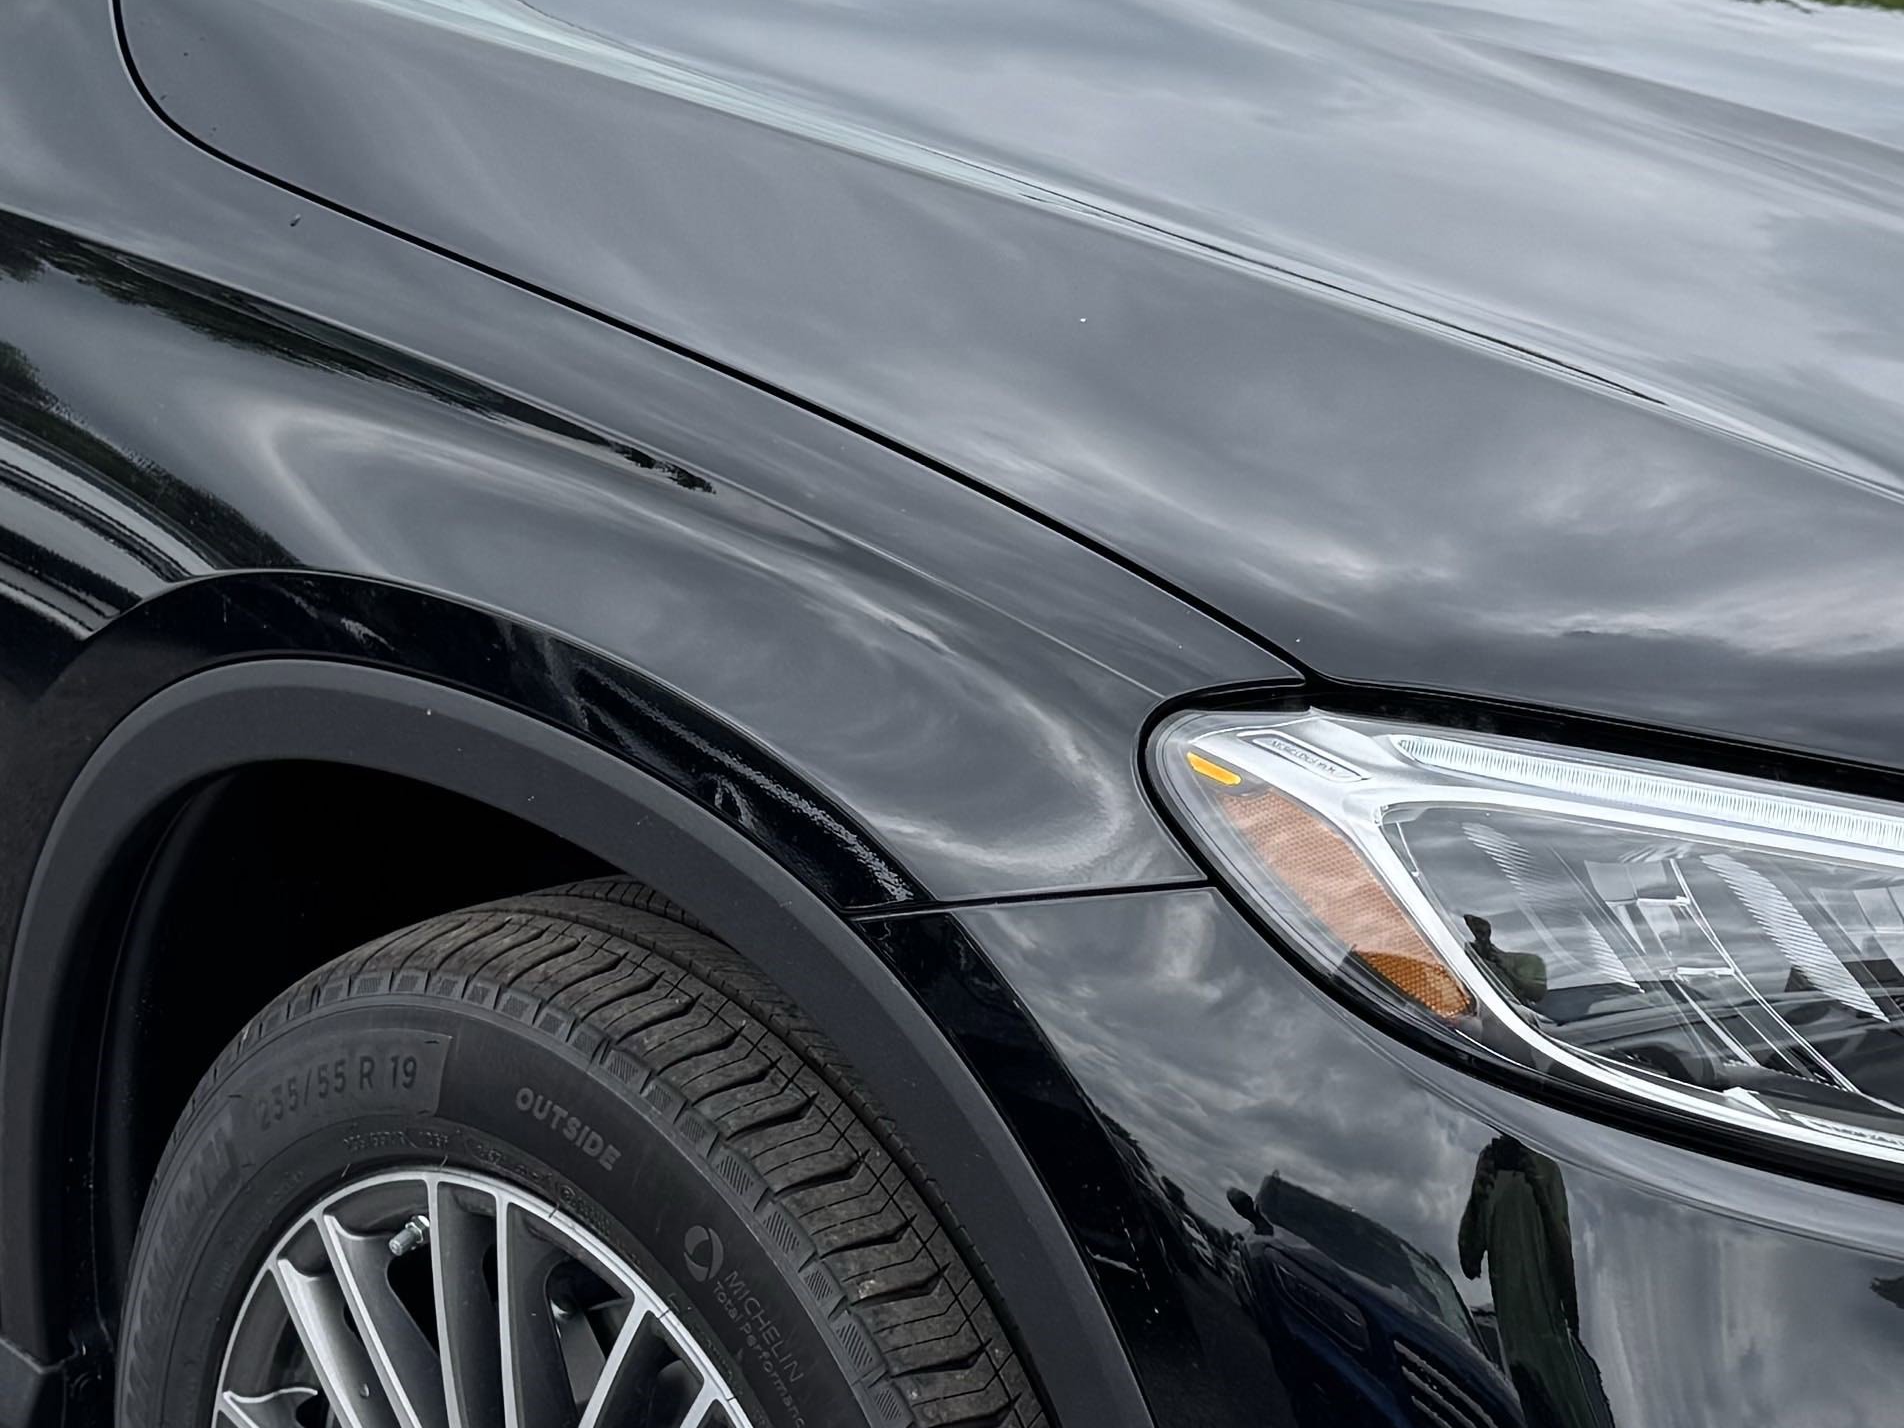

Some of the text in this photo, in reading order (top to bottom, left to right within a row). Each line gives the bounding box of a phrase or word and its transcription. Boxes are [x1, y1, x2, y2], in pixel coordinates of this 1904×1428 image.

[359, 1055, 376, 1090] R
[390, 1055, 418, 1090] 19
[515, 1087, 623, 1172] OUTSIDE
[712, 1280, 745, 1325] Total
[725, 1270, 806, 1383] MICHELIN
